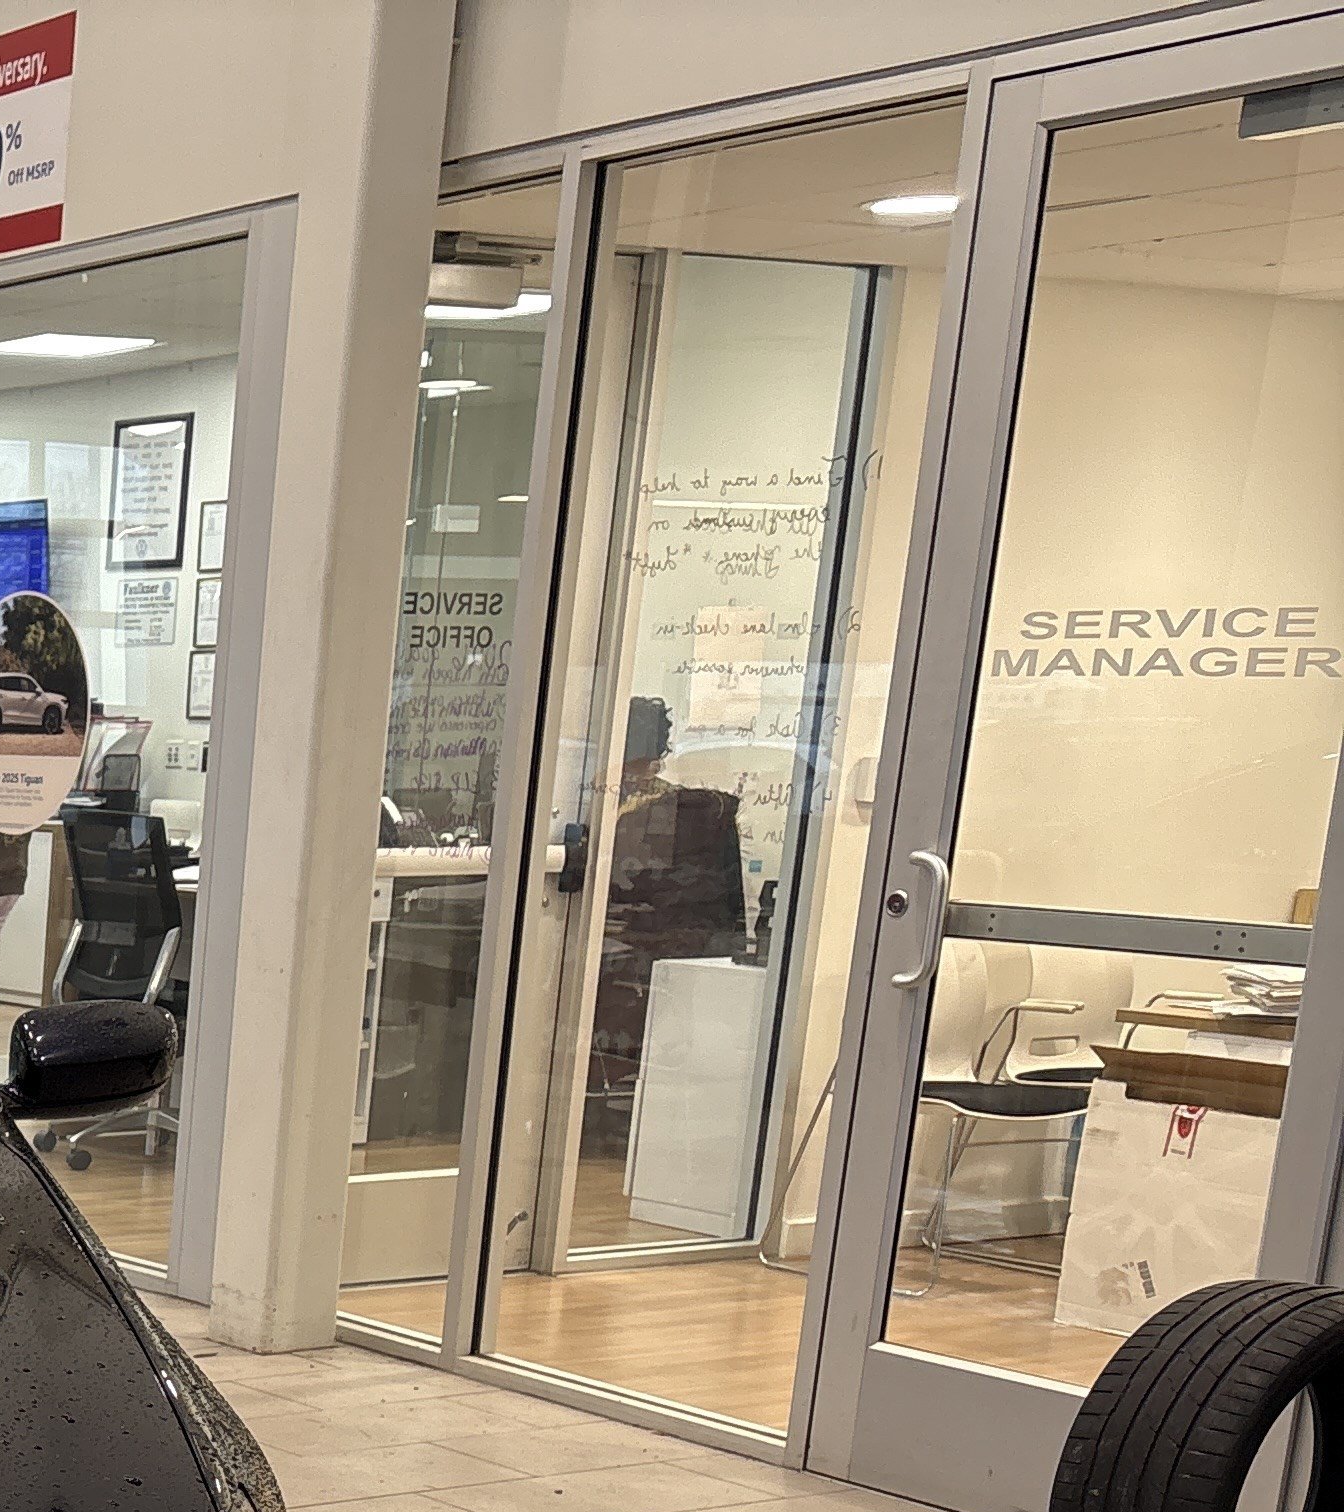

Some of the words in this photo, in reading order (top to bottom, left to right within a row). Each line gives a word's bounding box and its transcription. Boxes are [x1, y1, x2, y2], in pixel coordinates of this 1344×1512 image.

[7, 167, 25, 187] Off
[25, 159, 55, 182] MSRP
[1020, 607, 1320, 640] SERVICE
[990, 647, 1343, 678] MANAGER
[2, 772, 19, 784] 2025
[20, 773, 43, 787] Tiguan
